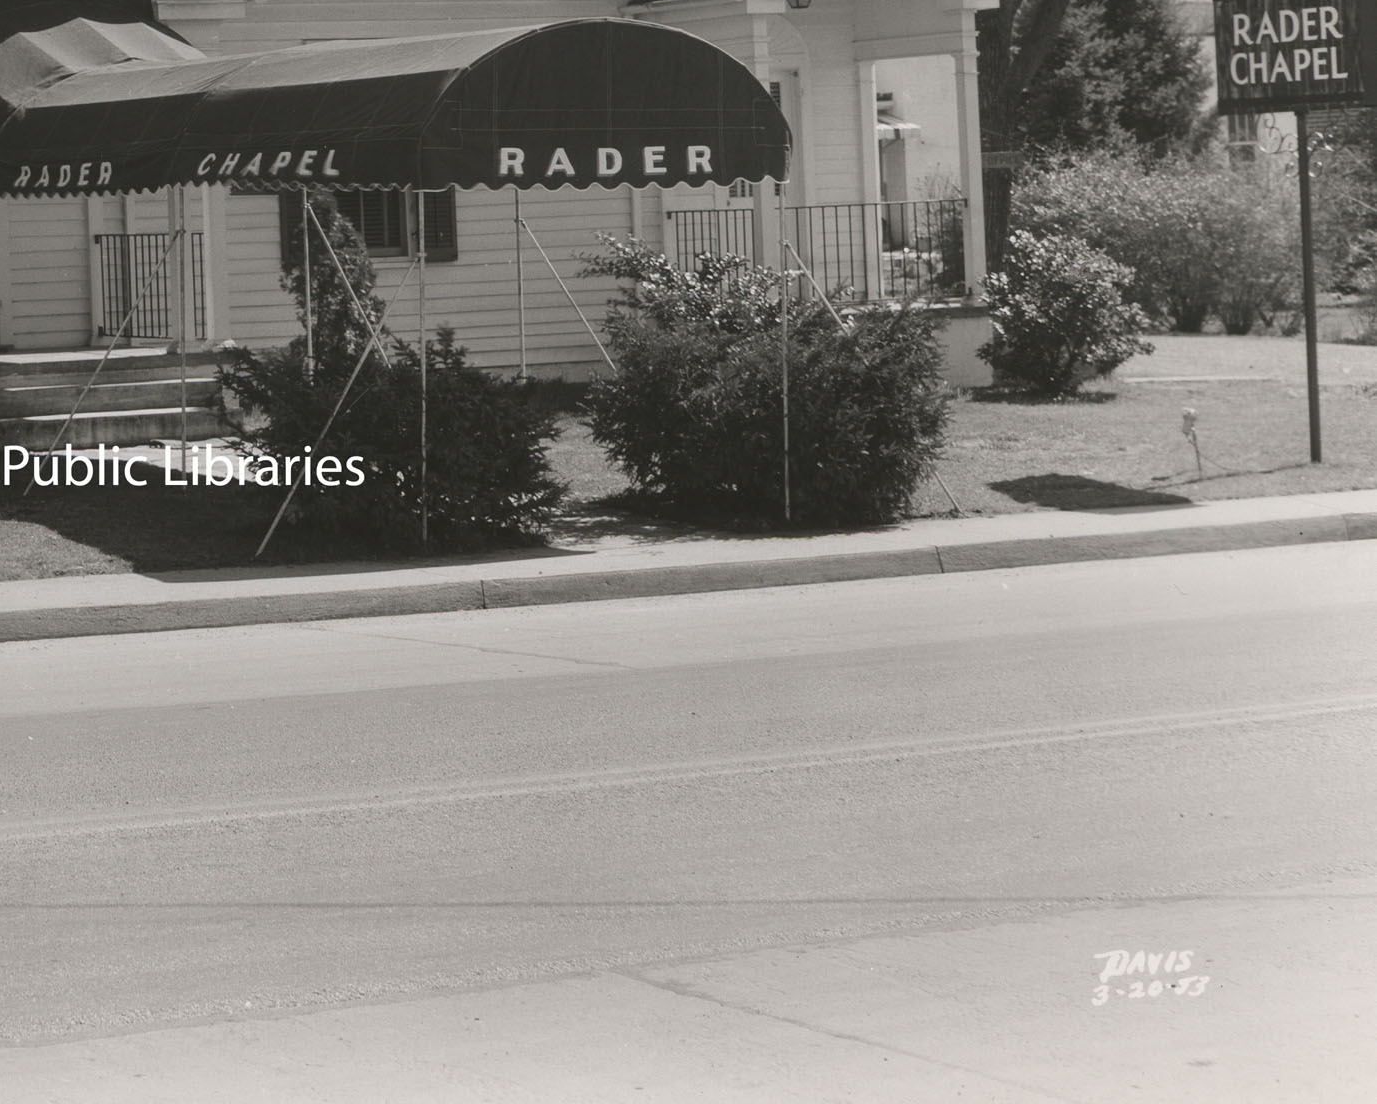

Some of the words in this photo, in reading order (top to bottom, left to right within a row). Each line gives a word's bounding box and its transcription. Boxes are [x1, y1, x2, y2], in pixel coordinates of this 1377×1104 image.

[1233, 6, 1344, 46] RADER
[1230, 46, 1349, 85] CHAPEL
[14, 162, 113, 188] RADER
[197, 149, 340, 176] CHAPEL
[498, 145, 713, 177] RADER
